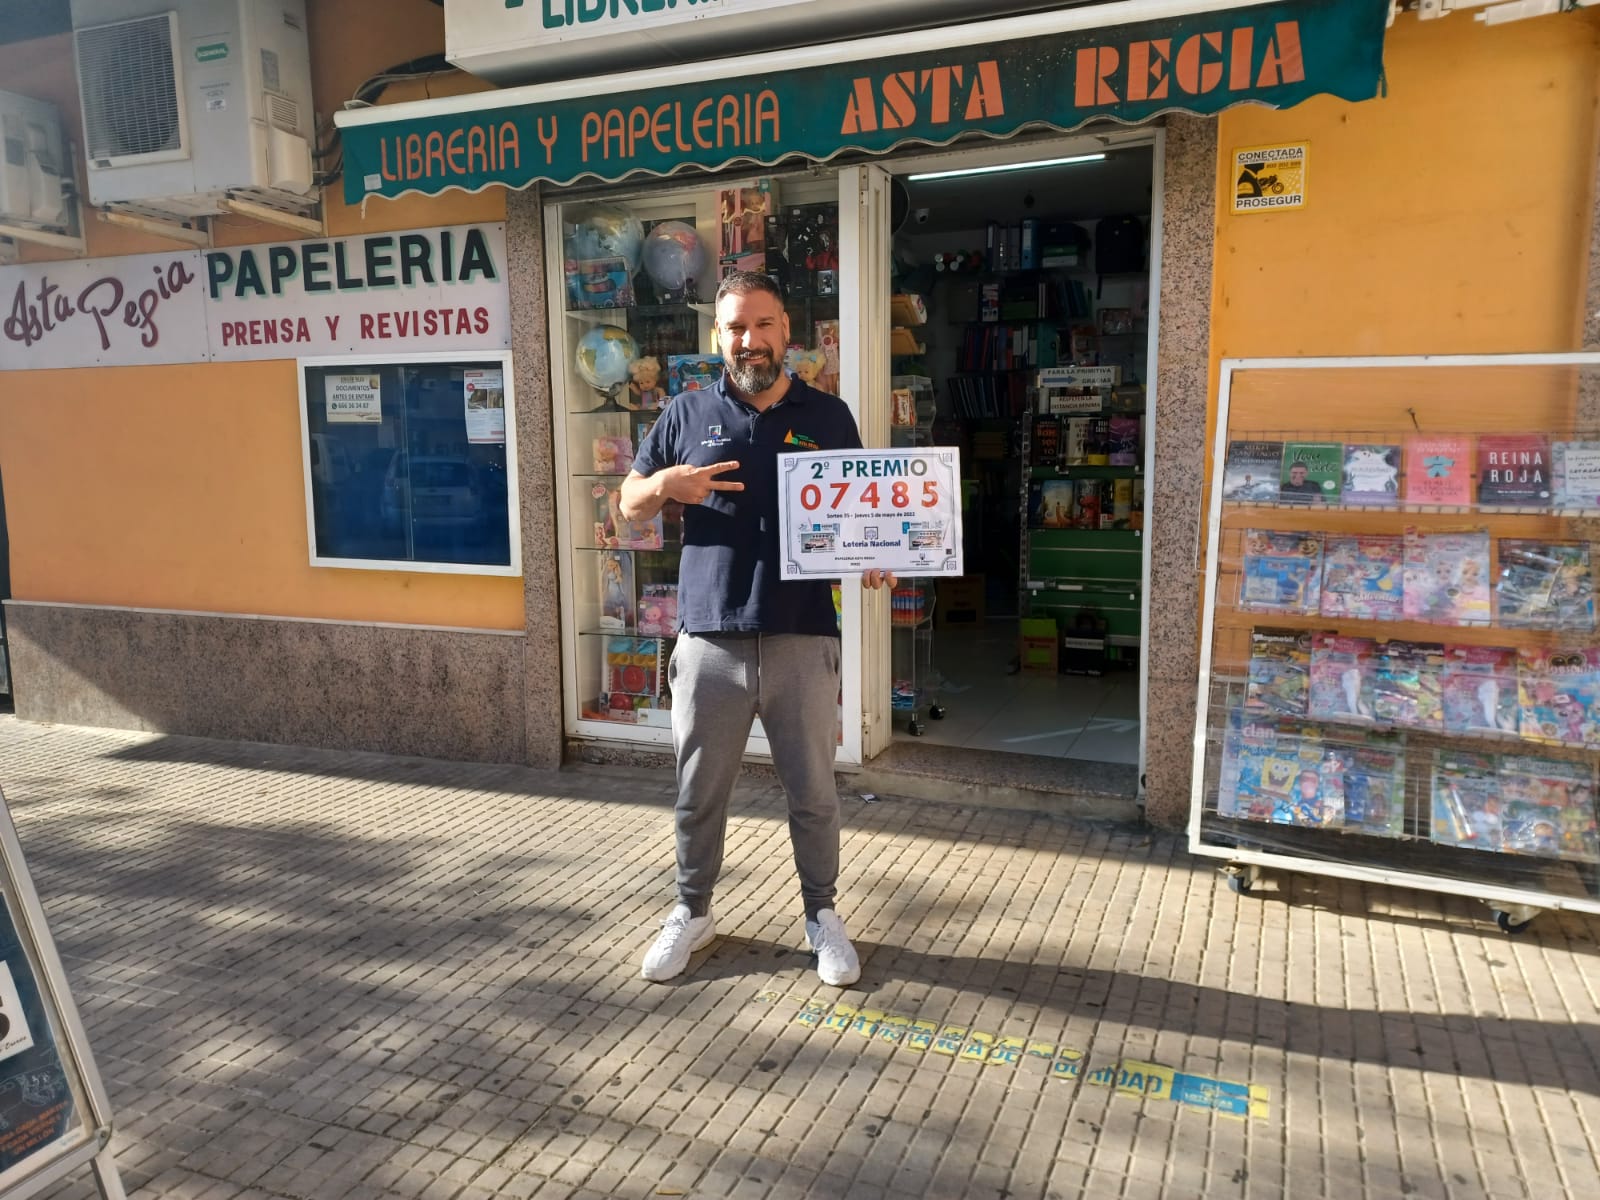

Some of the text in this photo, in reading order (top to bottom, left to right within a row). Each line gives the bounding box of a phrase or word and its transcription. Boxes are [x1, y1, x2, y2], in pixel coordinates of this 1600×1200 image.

[840, 20, 1305, 135] ASTA REGIA
[380, 89, 780, 182] LIBRERIA Y PAPELERIA
[1238, 147, 1303, 161] CONECTADA
[1236, 195, 1302, 209] PROSEGUR
[207, 229, 500, 300] PAPELERIA
[4, 276, 76, 347] Asta
[221, 307, 490, 347] PRENSA Y REVISTAS
[810, 458, 928, 479] 2º PREMIO
[1488, 451, 1543, 465] REINA
[1490, 468, 1543, 483] ROJA
[800, 480, 940, 511] 07485
[870, 539, 901, 547] Nacional
